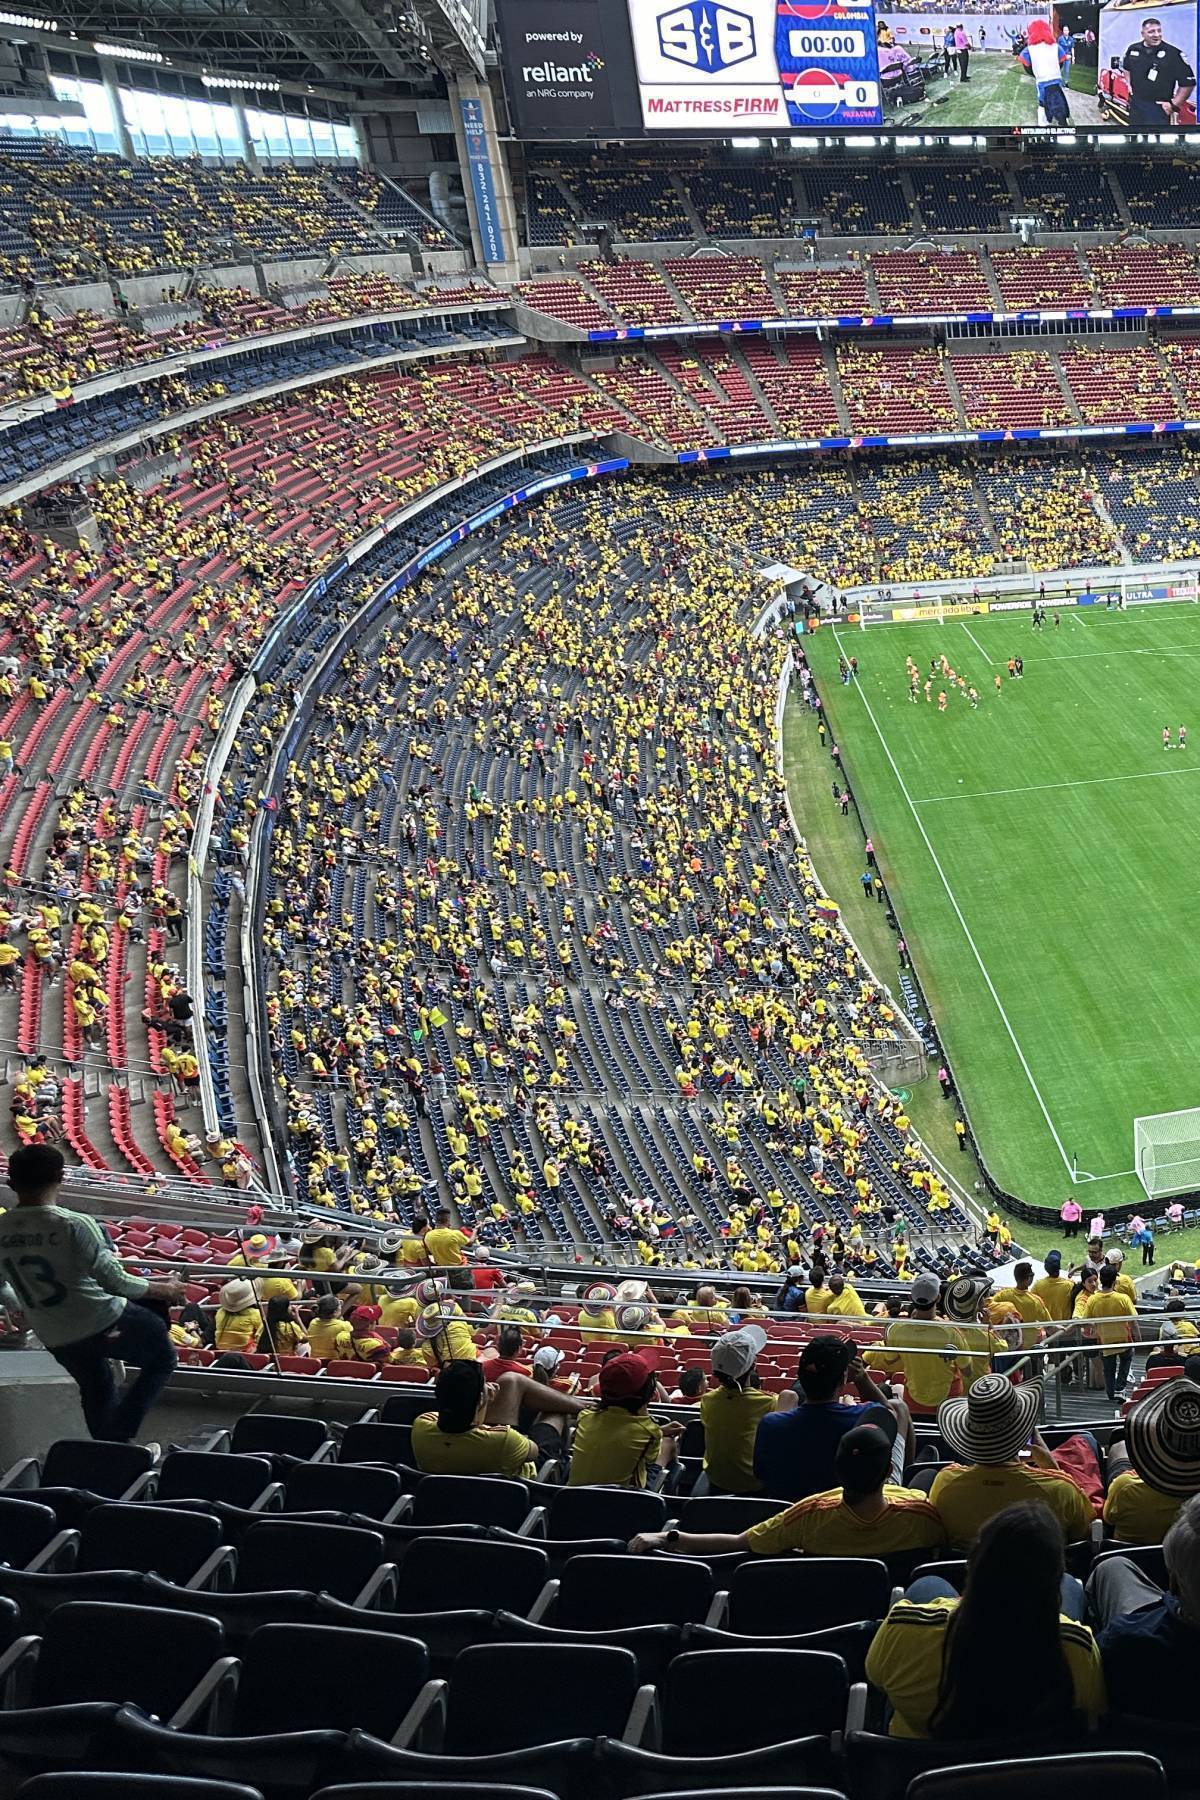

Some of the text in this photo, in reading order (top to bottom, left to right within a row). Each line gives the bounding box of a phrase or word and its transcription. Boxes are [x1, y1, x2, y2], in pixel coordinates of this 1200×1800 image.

[525, 31, 583, 43] powered by
[801, 36, 855, 53] 00:00
[522, 62, 593, 82] reliant
[537, 89, 556, 98] NRG
[557, 90, 594, 99] company
[856, 87, 867, 102] 0
[1126, 591, 1153, 600] ULTRA
